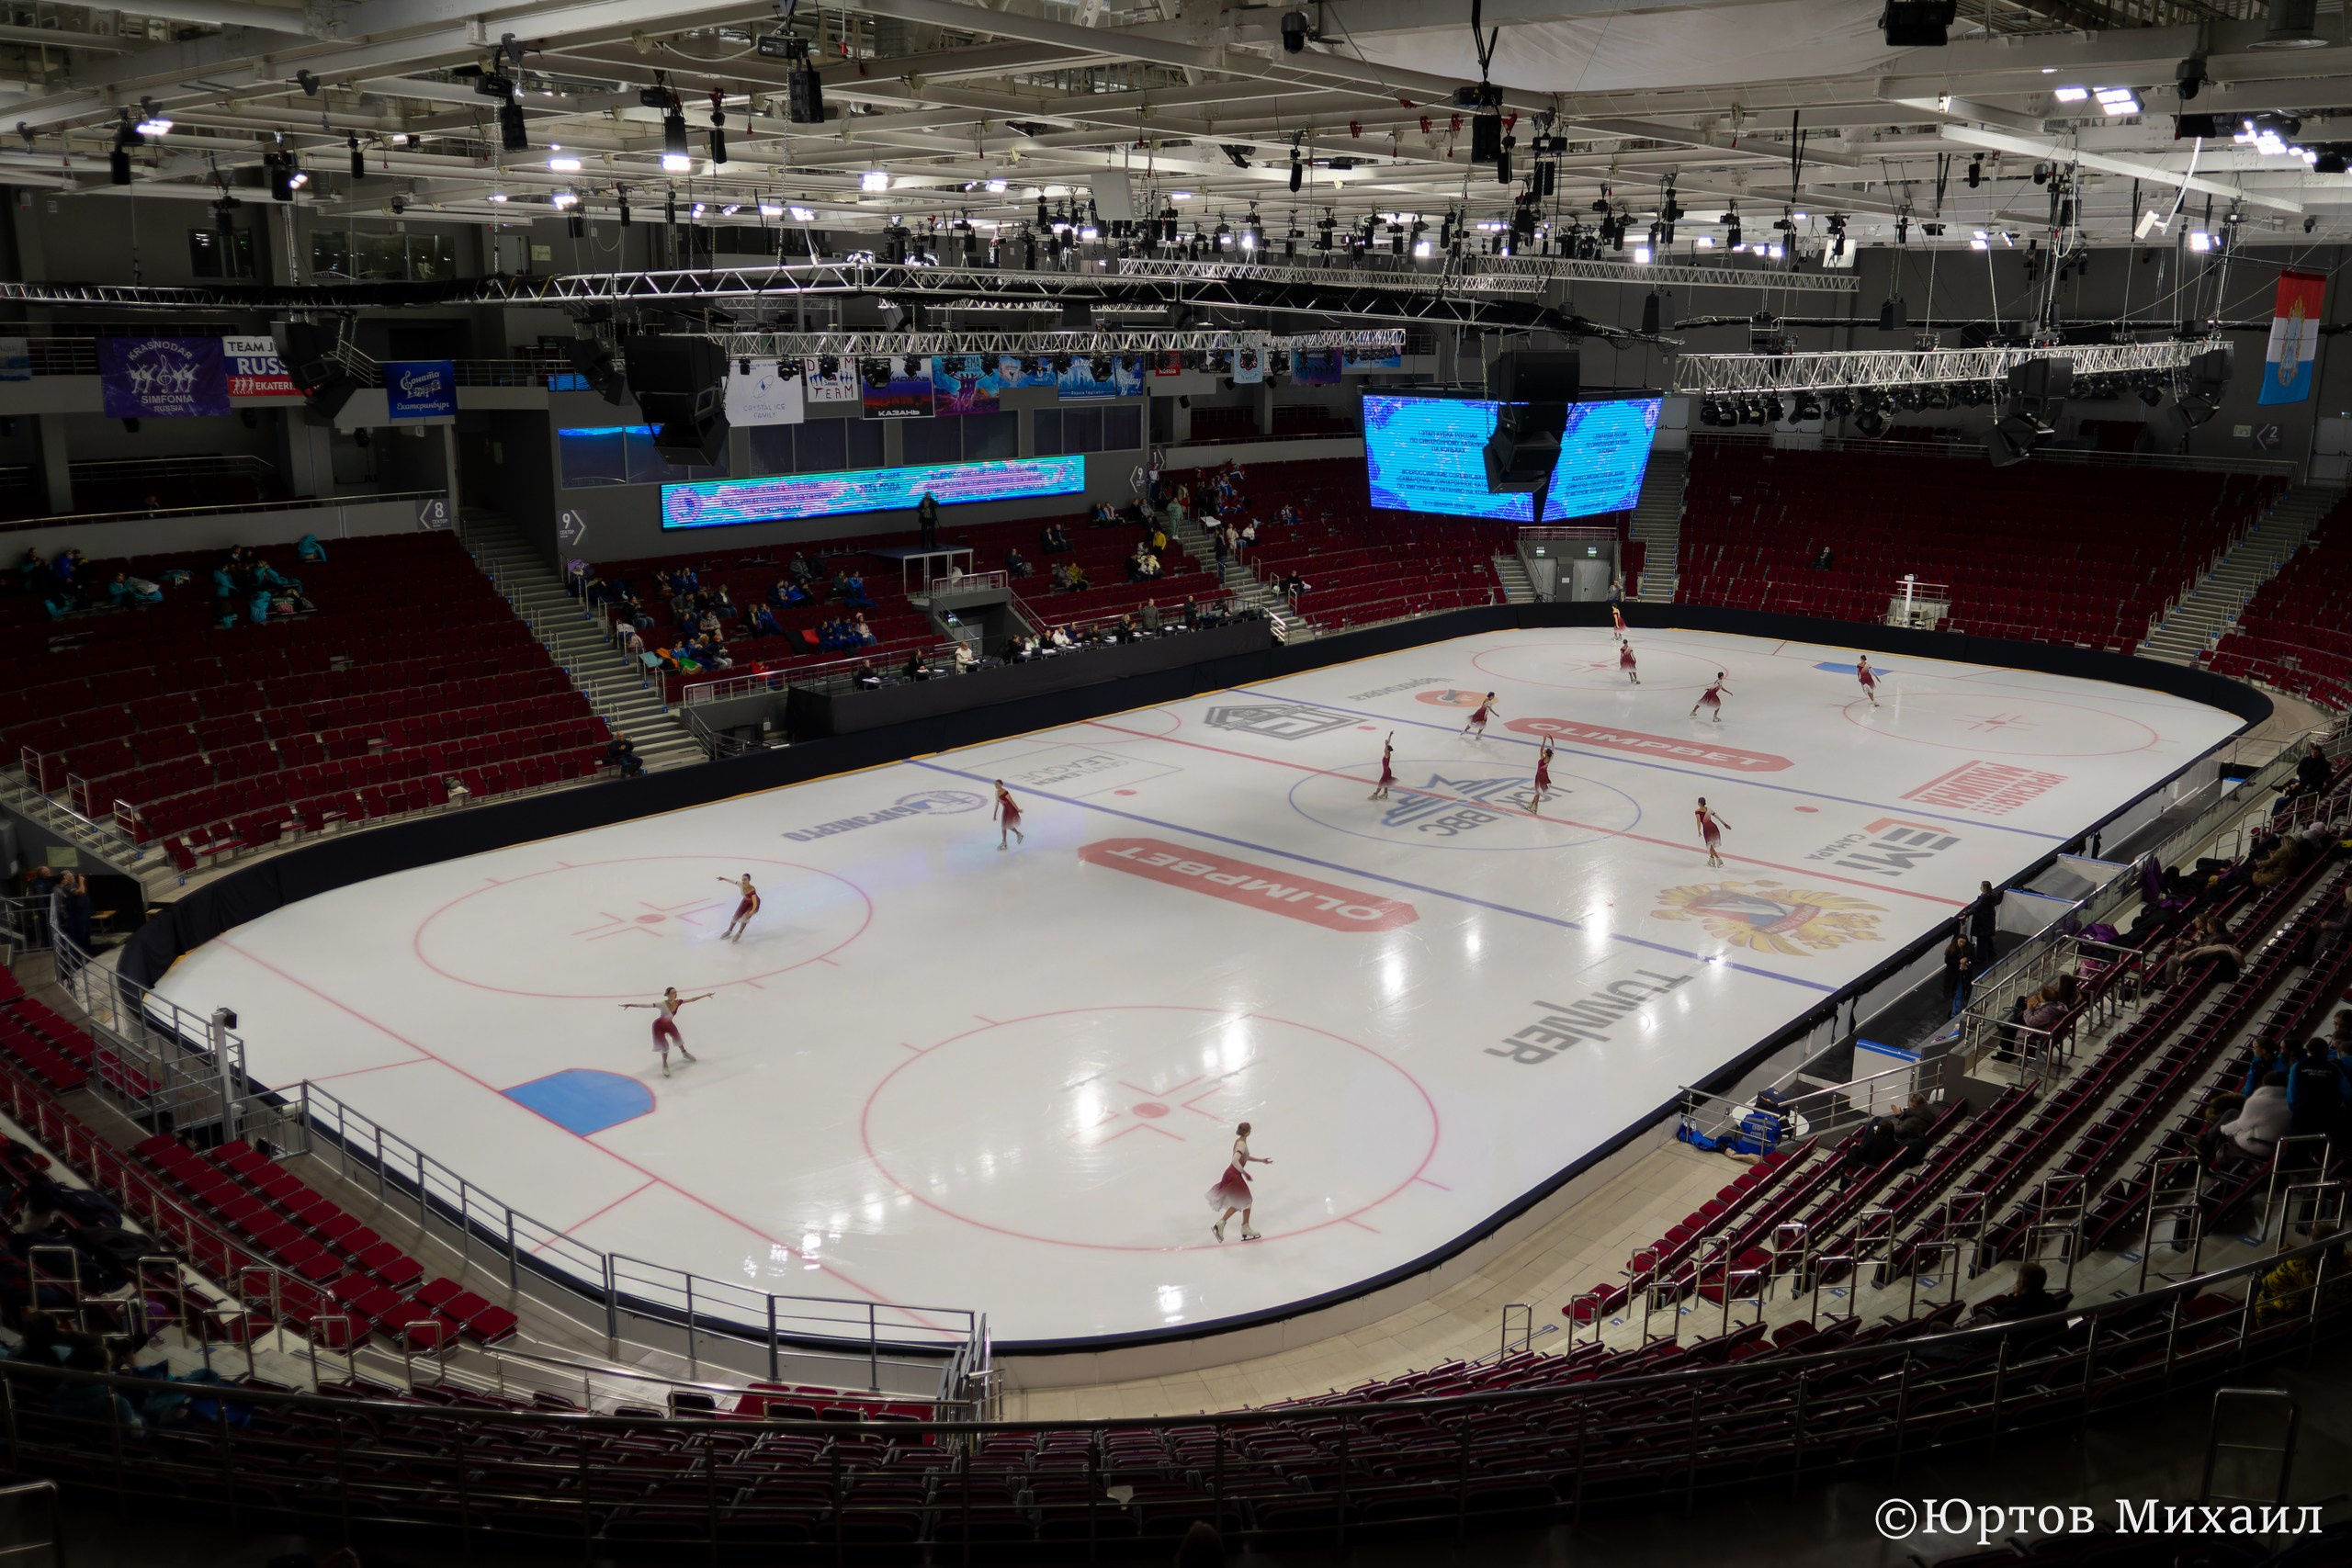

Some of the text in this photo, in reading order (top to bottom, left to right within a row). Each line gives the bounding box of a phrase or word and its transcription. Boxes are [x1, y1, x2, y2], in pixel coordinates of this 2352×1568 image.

[126, 340, 194, 361] KRASNODAR
[227, 341, 265, 353] TEAM
[141, 394, 195, 404] SIMFONIA
[813, 384, 854, 400] TEAM
[153, 405, 185, 413] RUSSIA
[396, 401, 451, 412] Екатеринбург
[877, 409, 921, 417] КАЗАНЬ
[2269, 425, 2278, 438] 2
[1137, 467, 1143, 480] 9
[434, 502, 444, 518] 8
[562, 513, 571, 529] 9
[1527, 722, 1770, 766] OLIMPBET
[1007, 754, 1115, 784] LEAGUE
[1912, 761, 2034, 809] МАШИНА
[1990, 770, 2069, 808] КРАСНАЯ
[782, 805, 922, 842] БУРЭНЕРГО
[1803, 832, 1867, 862] САМАРА
[1104, 846, 1384, 920] OLIMPBET
[1483, 968, 1694, 1066] TUNNER
